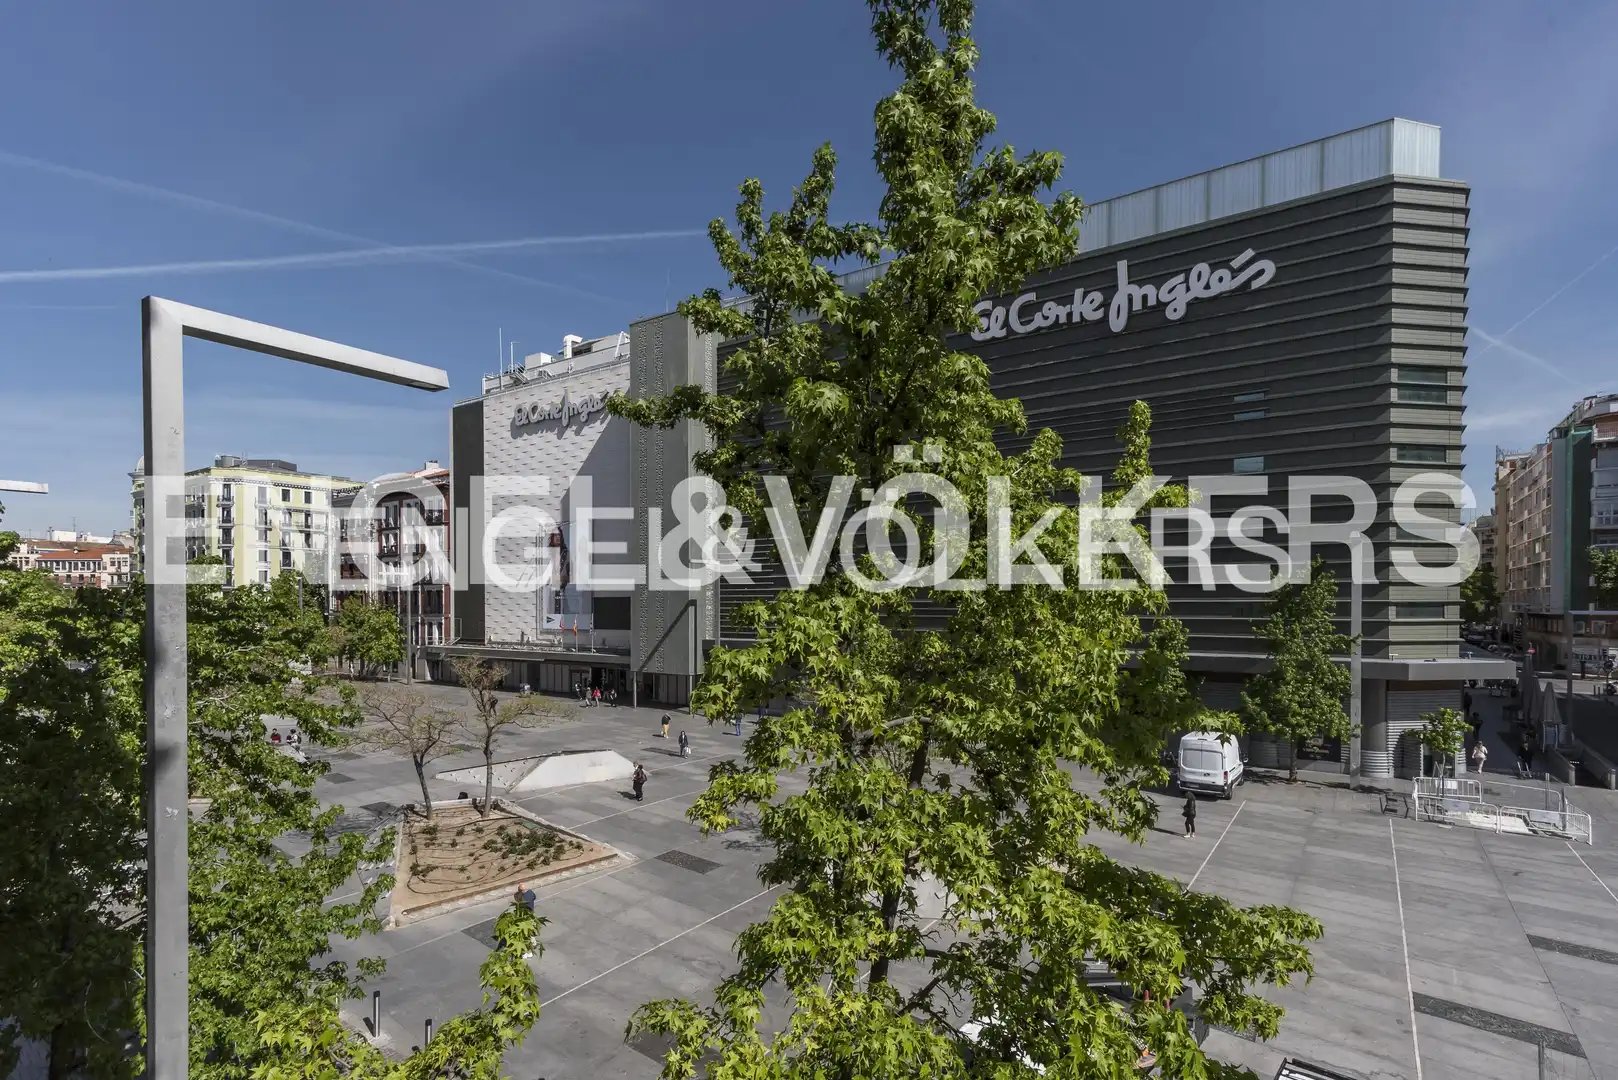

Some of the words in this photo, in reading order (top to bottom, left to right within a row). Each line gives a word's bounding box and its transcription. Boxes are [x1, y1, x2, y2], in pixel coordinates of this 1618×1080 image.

[971, 300, 1007, 341] El
[1009, 288, 1104, 334] Corte
[1109, 248, 1277, 333] Inglés
[514, 404, 529, 426] El
[528, 401, 561, 423] Corte
[561, 388, 609, 427] Inglé
